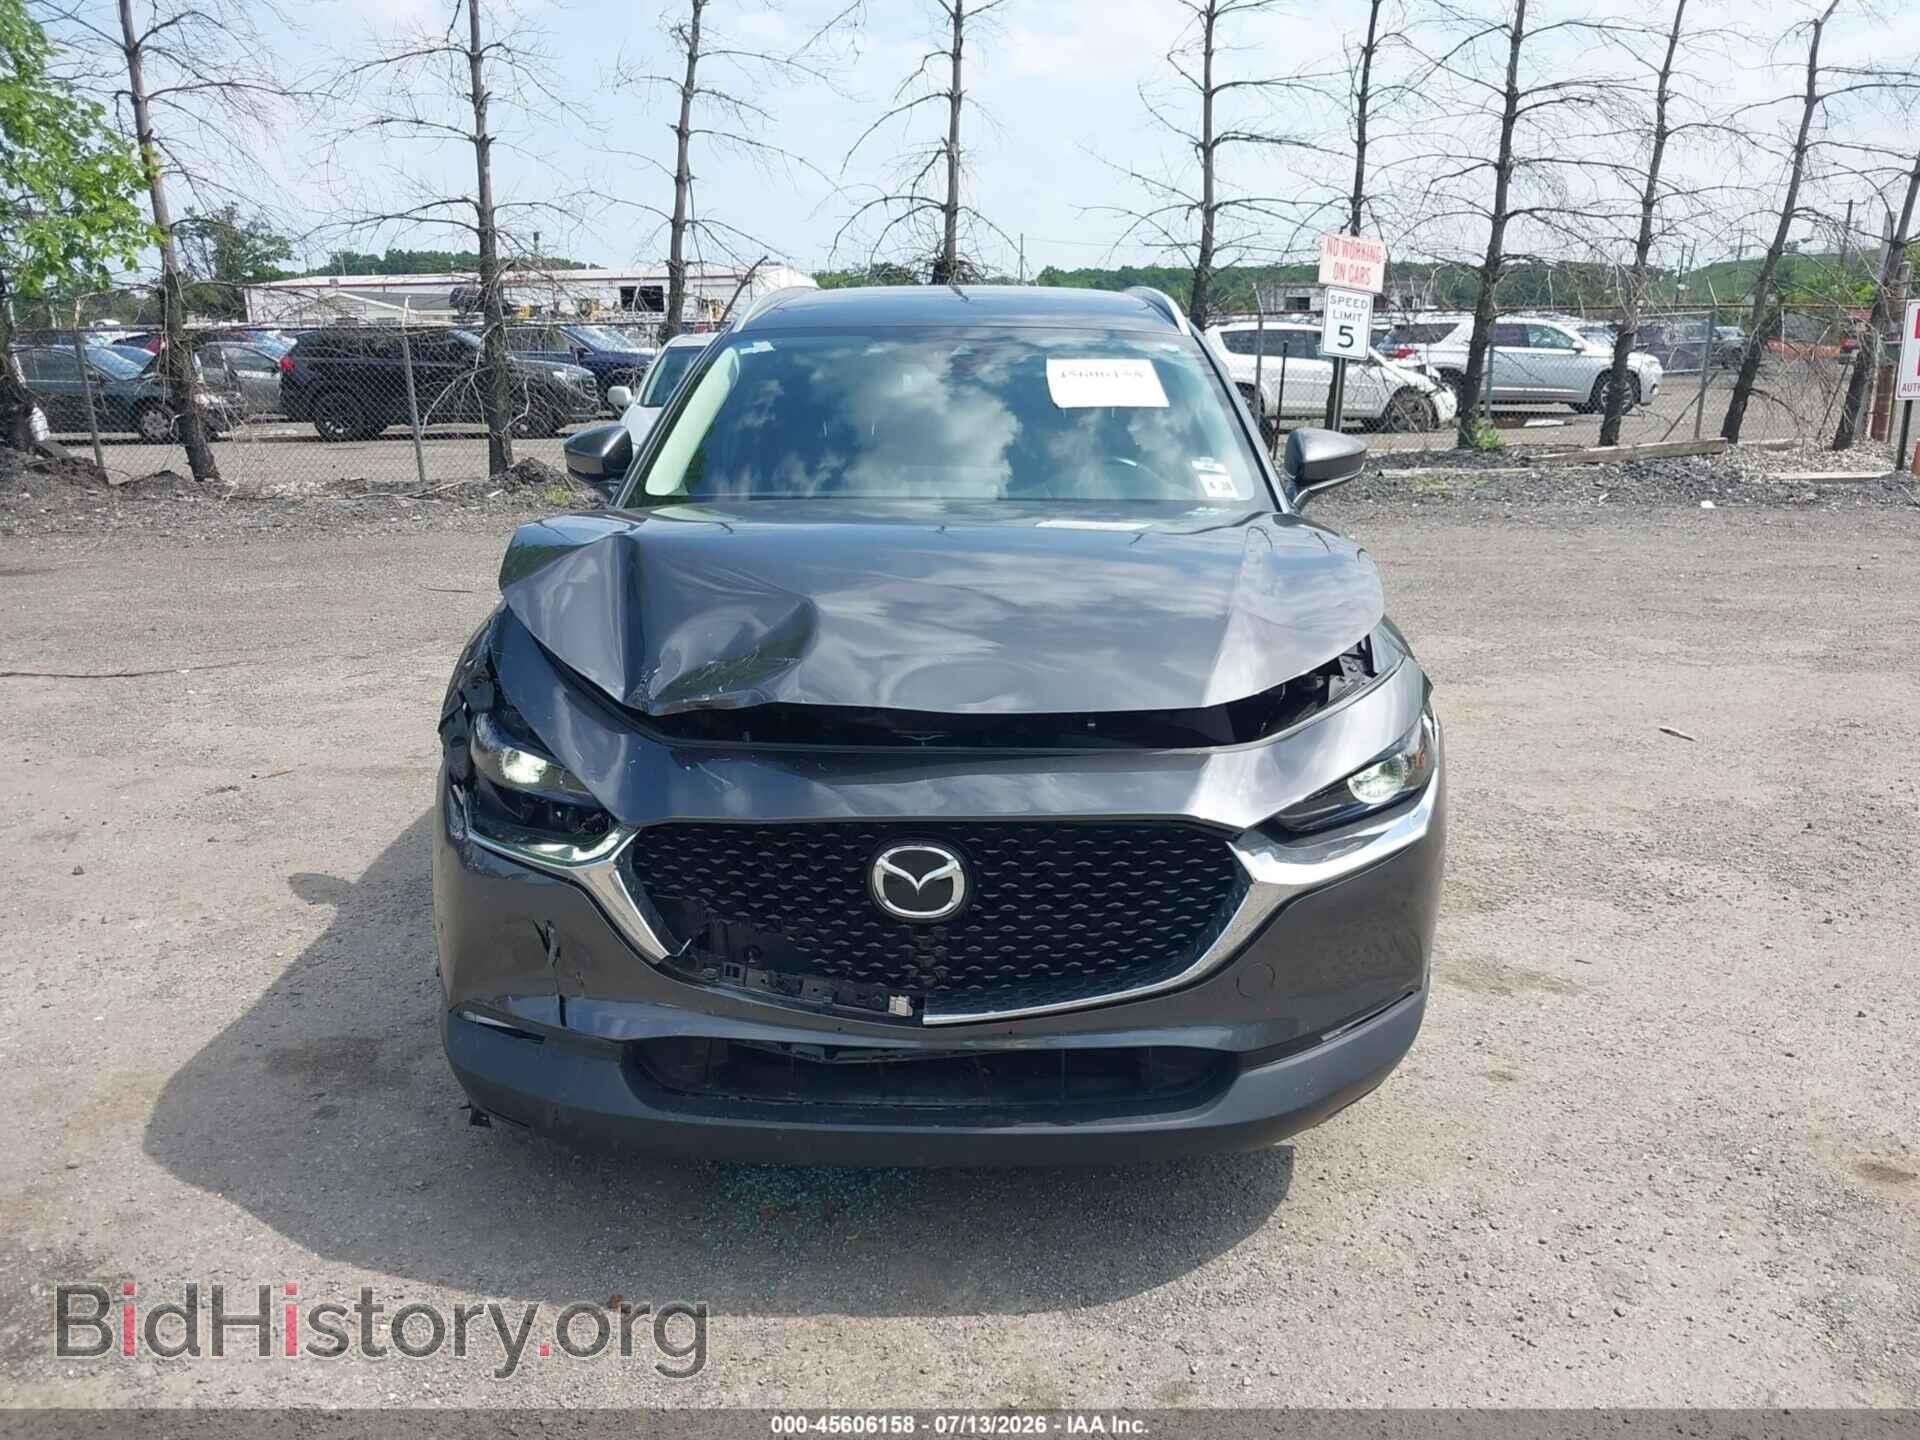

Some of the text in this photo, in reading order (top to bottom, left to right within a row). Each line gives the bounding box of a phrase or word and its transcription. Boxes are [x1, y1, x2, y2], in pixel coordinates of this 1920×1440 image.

[1327, 237, 1383, 264] NO WORKING
[1334, 262, 1371, 285] ON CARS
[1329, 294, 1368, 310] SPEED
[1333, 309, 1362, 323] LIMIT
[1337, 325, 1354, 349] 5
